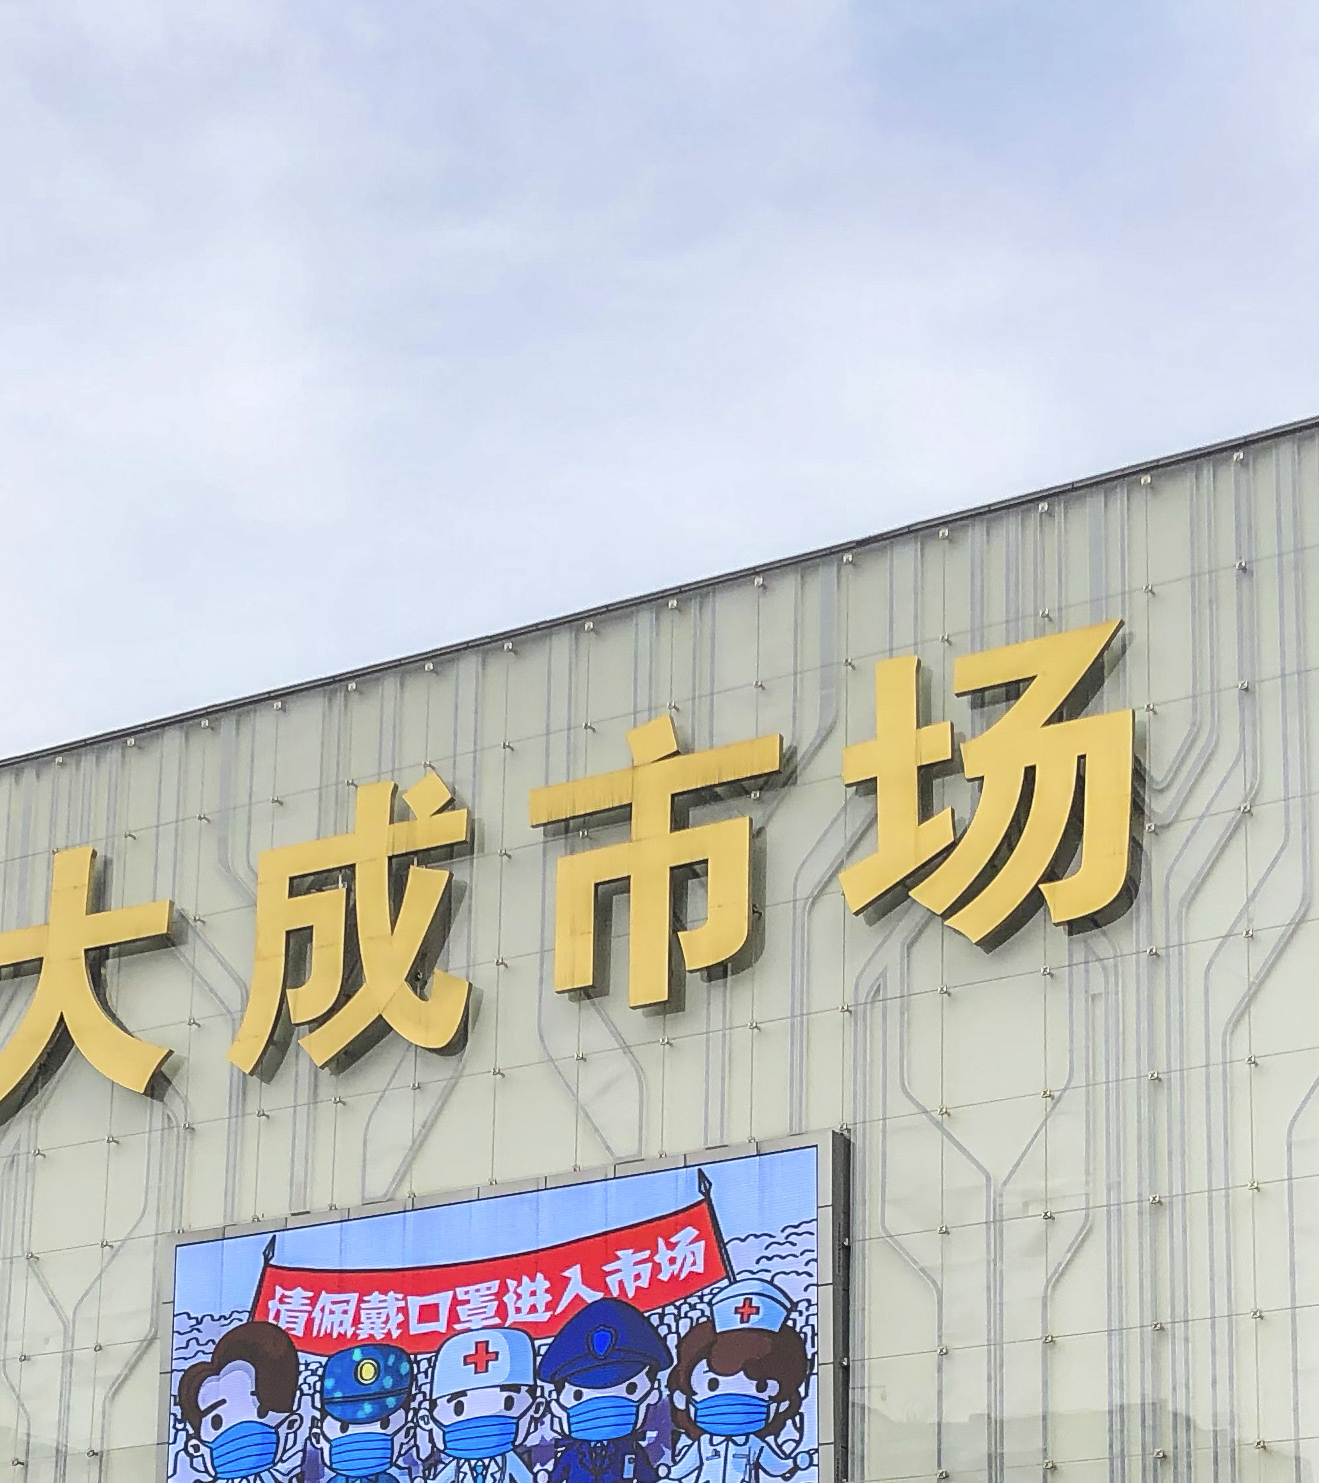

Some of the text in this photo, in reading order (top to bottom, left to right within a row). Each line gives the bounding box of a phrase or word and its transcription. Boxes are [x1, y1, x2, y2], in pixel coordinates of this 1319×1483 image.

[267, 1225, 706, 1343] 请佩戴口罩进入市场
